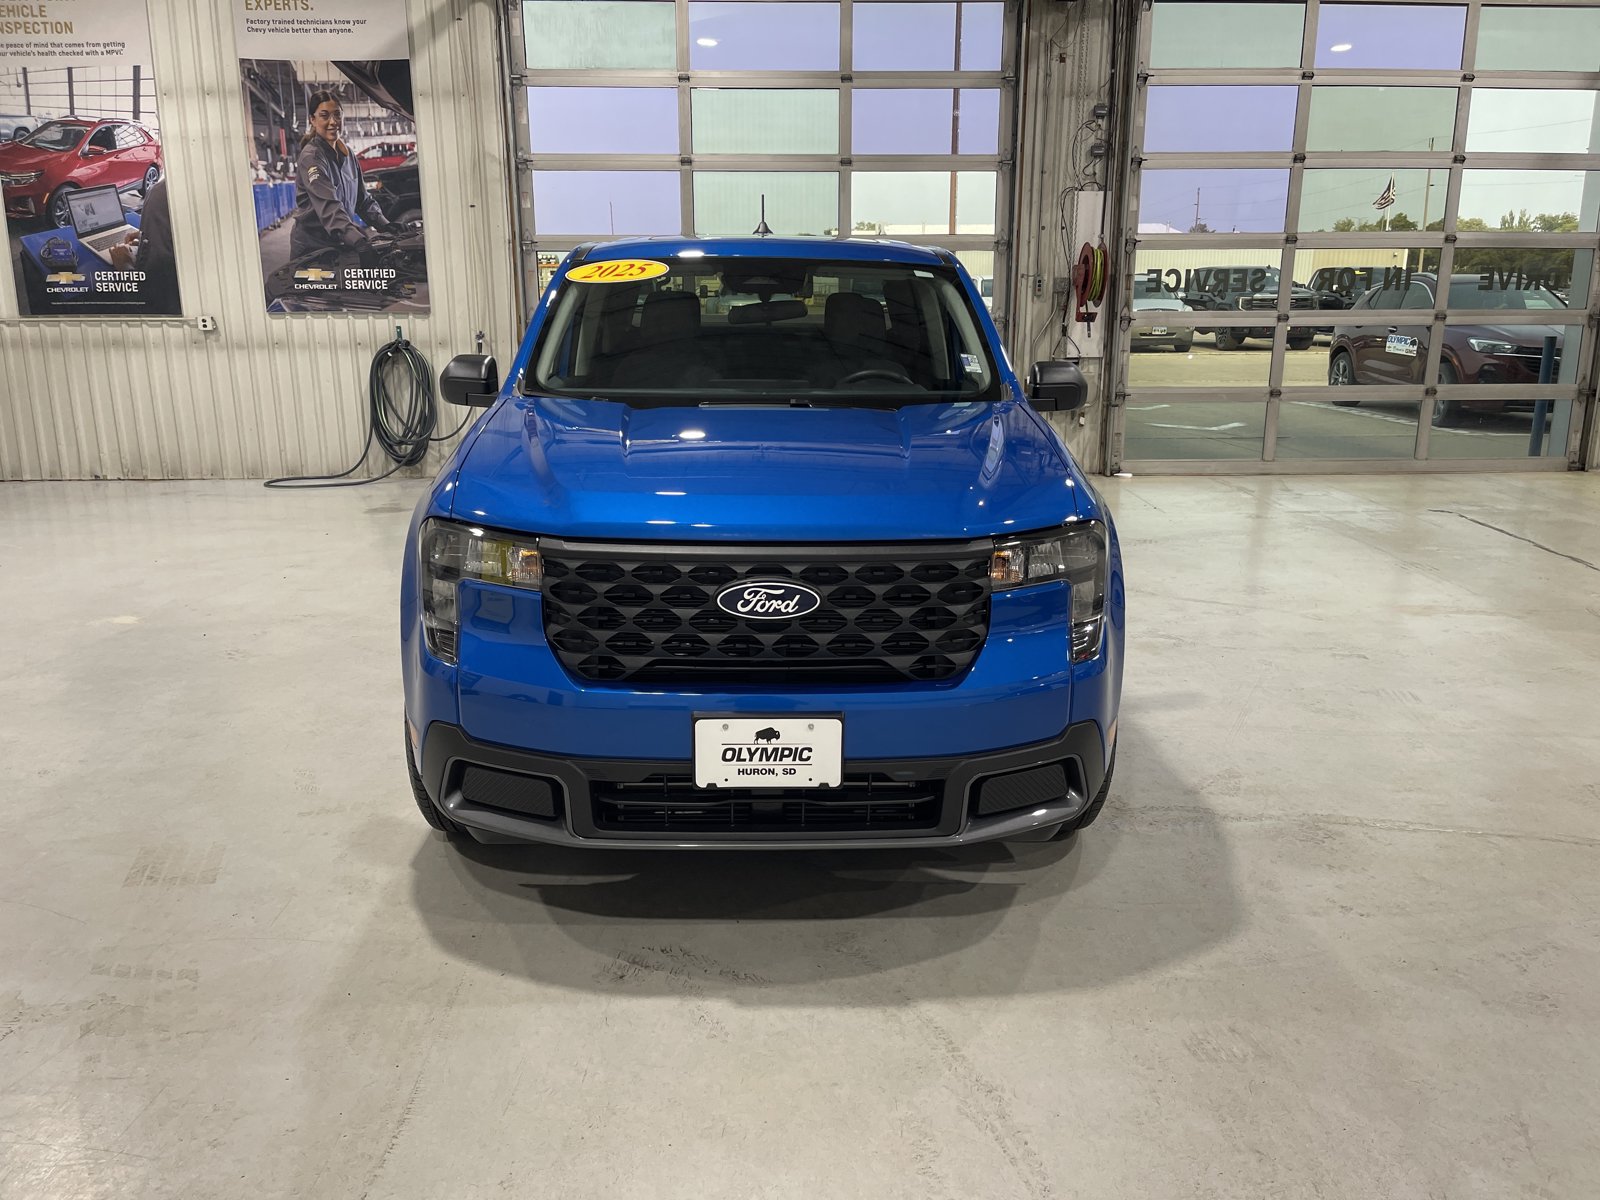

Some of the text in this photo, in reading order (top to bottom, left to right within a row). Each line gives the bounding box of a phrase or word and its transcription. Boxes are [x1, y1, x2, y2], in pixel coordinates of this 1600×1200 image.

[245, 0, 314, 11] EXPERTS.
[246, 18, 271, 26] Factory
[246, 26, 266, 34] Chevy
[102, 41, 126, 49] getting
[94, 271, 147, 281] CERTIFIED
[344, 268, 396, 279] CERTIFIED
[580, 263, 654, 279] 2025
[95, 282, 139, 293] SERVICE
[344, 279, 388, 290] SERVICE
[737, 587, 800, 613] Ford
[721, 746, 813, 763] OLYMPIC
[737, 767, 797, 776] HURON, SD
